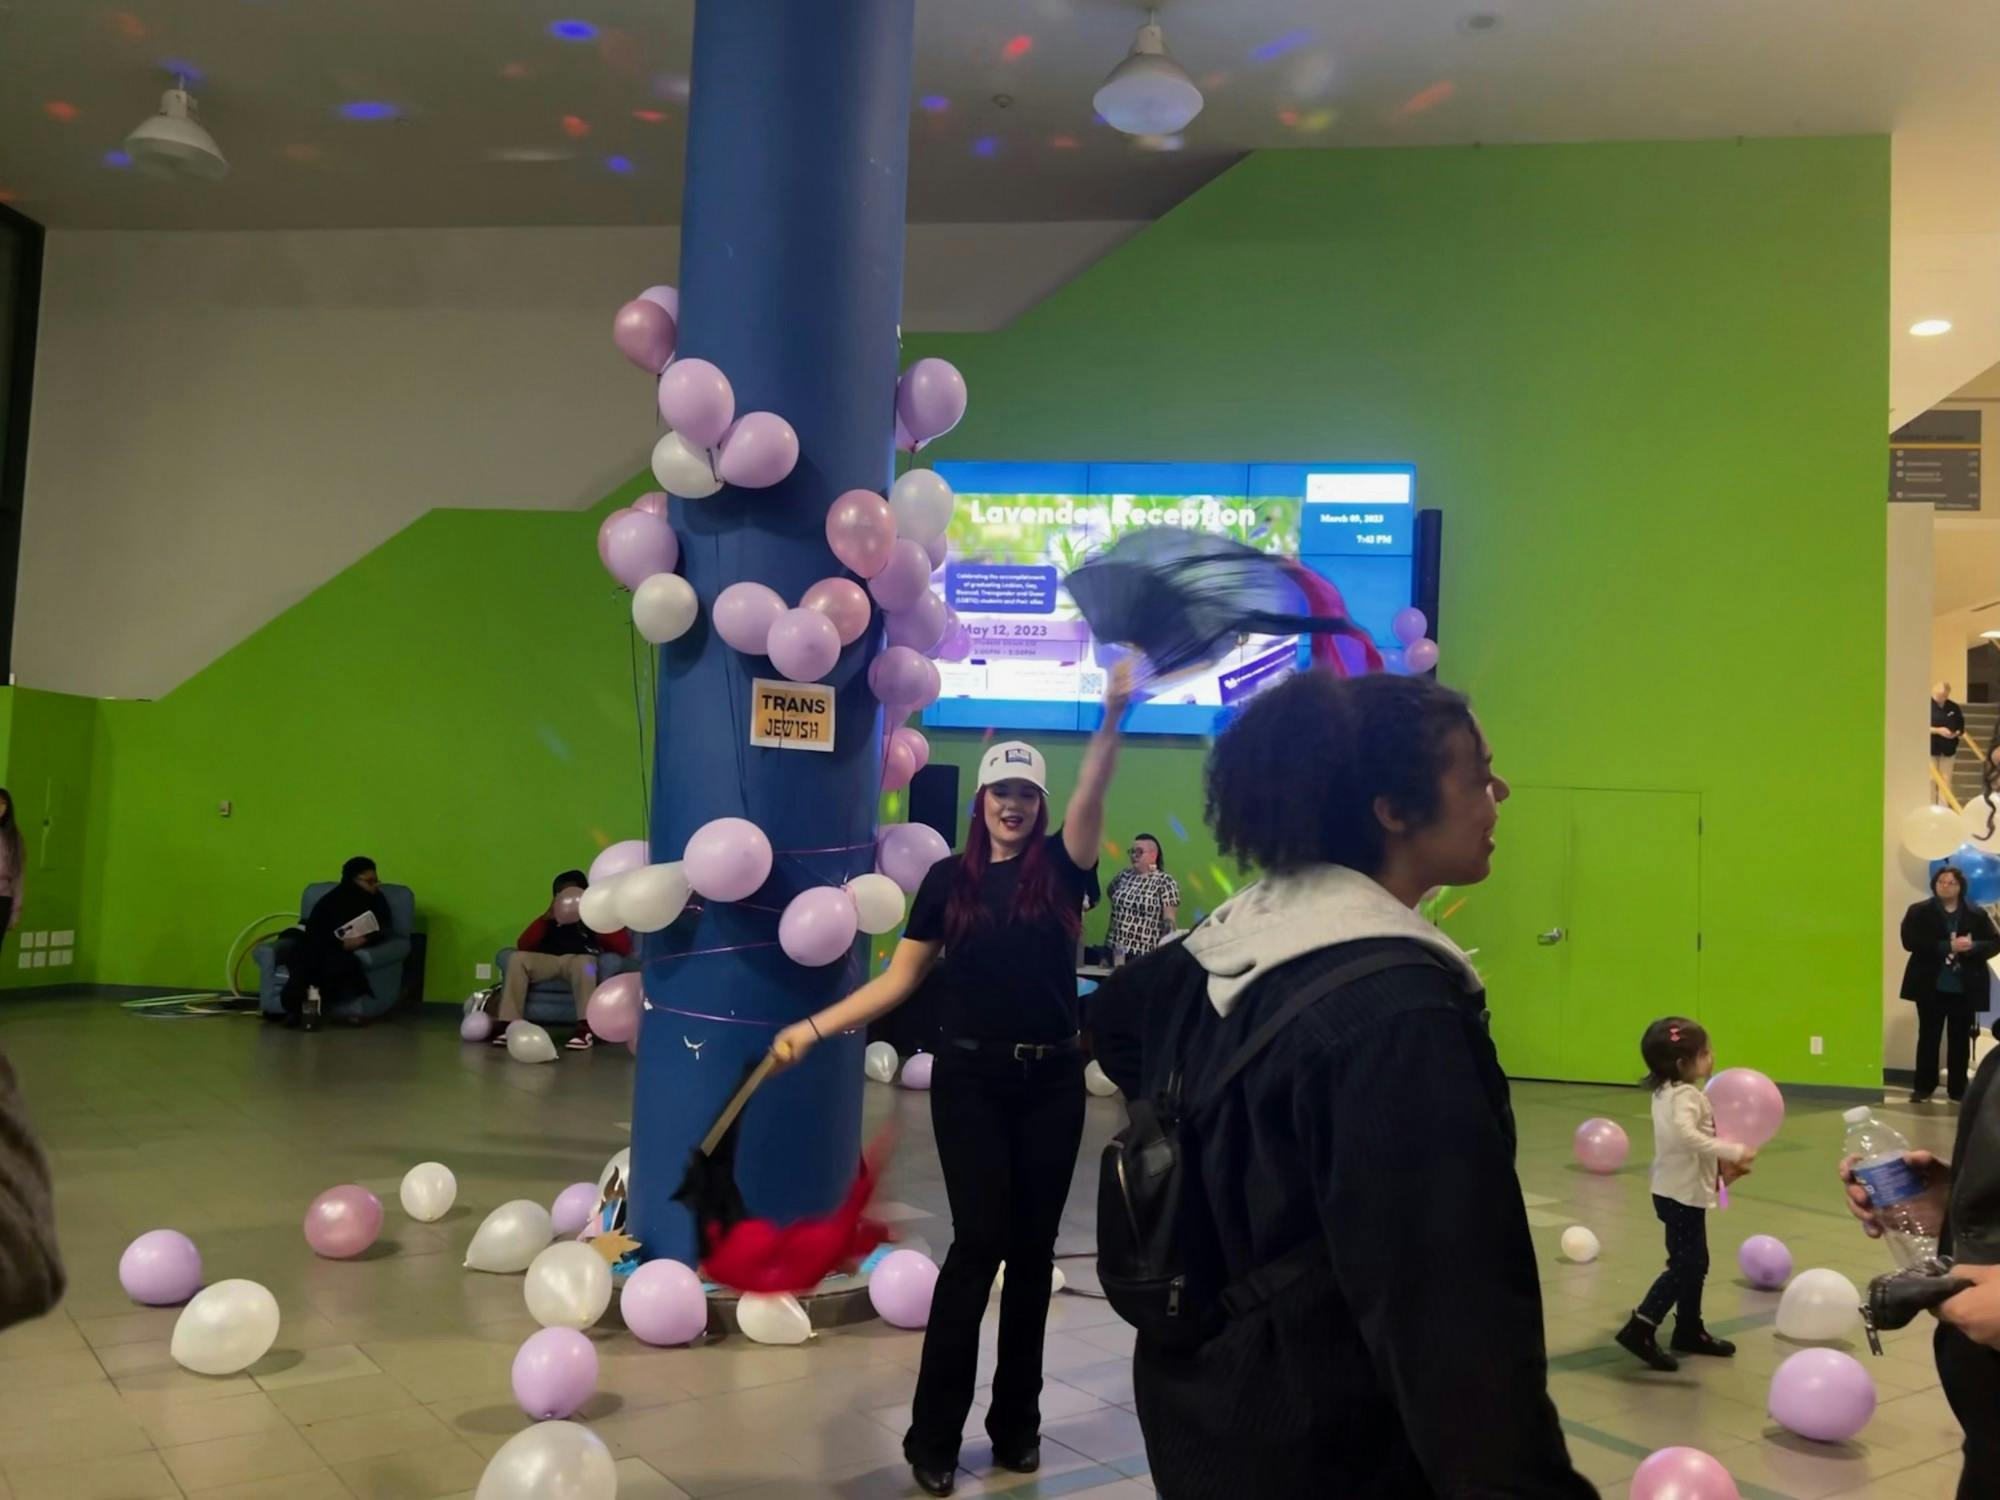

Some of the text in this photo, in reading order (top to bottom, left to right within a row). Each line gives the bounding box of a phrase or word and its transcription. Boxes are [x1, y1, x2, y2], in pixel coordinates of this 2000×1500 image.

[1320, 513, 1348, 523] March
[1375, 534, 1393, 544] PM
[960, 623, 989, 639] May
[1014, 624, 1048, 636] 2023
[761, 694, 826, 714] TRANS
[764, 717, 819, 739] JEWISH
